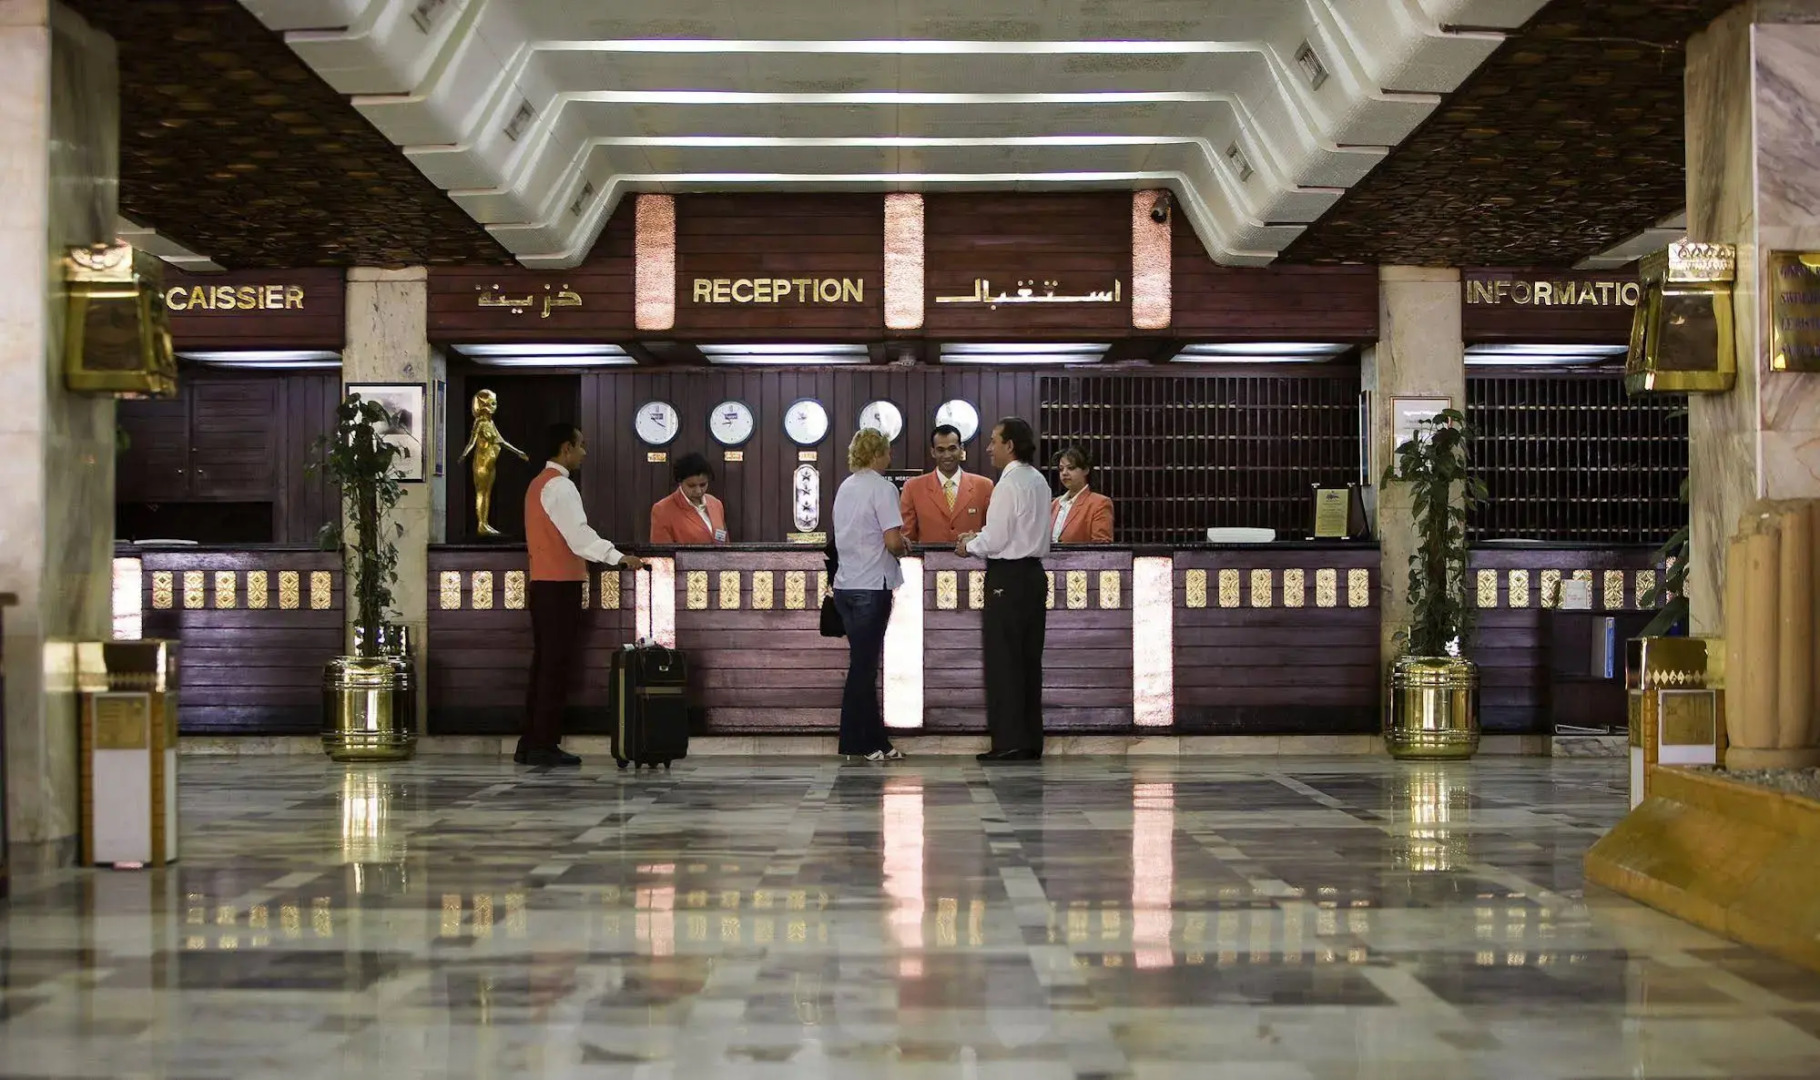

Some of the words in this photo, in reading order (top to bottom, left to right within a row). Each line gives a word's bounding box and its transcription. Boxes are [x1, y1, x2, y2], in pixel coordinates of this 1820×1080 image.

[165, 285, 305, 310] CAISSIER
[475, 283, 583, 318] خزينة
[692, 278, 864, 303] RECEPTION
[935, 278, 1121, 310] استقبال
[1466, 280, 1640, 306] INFORMATIO
